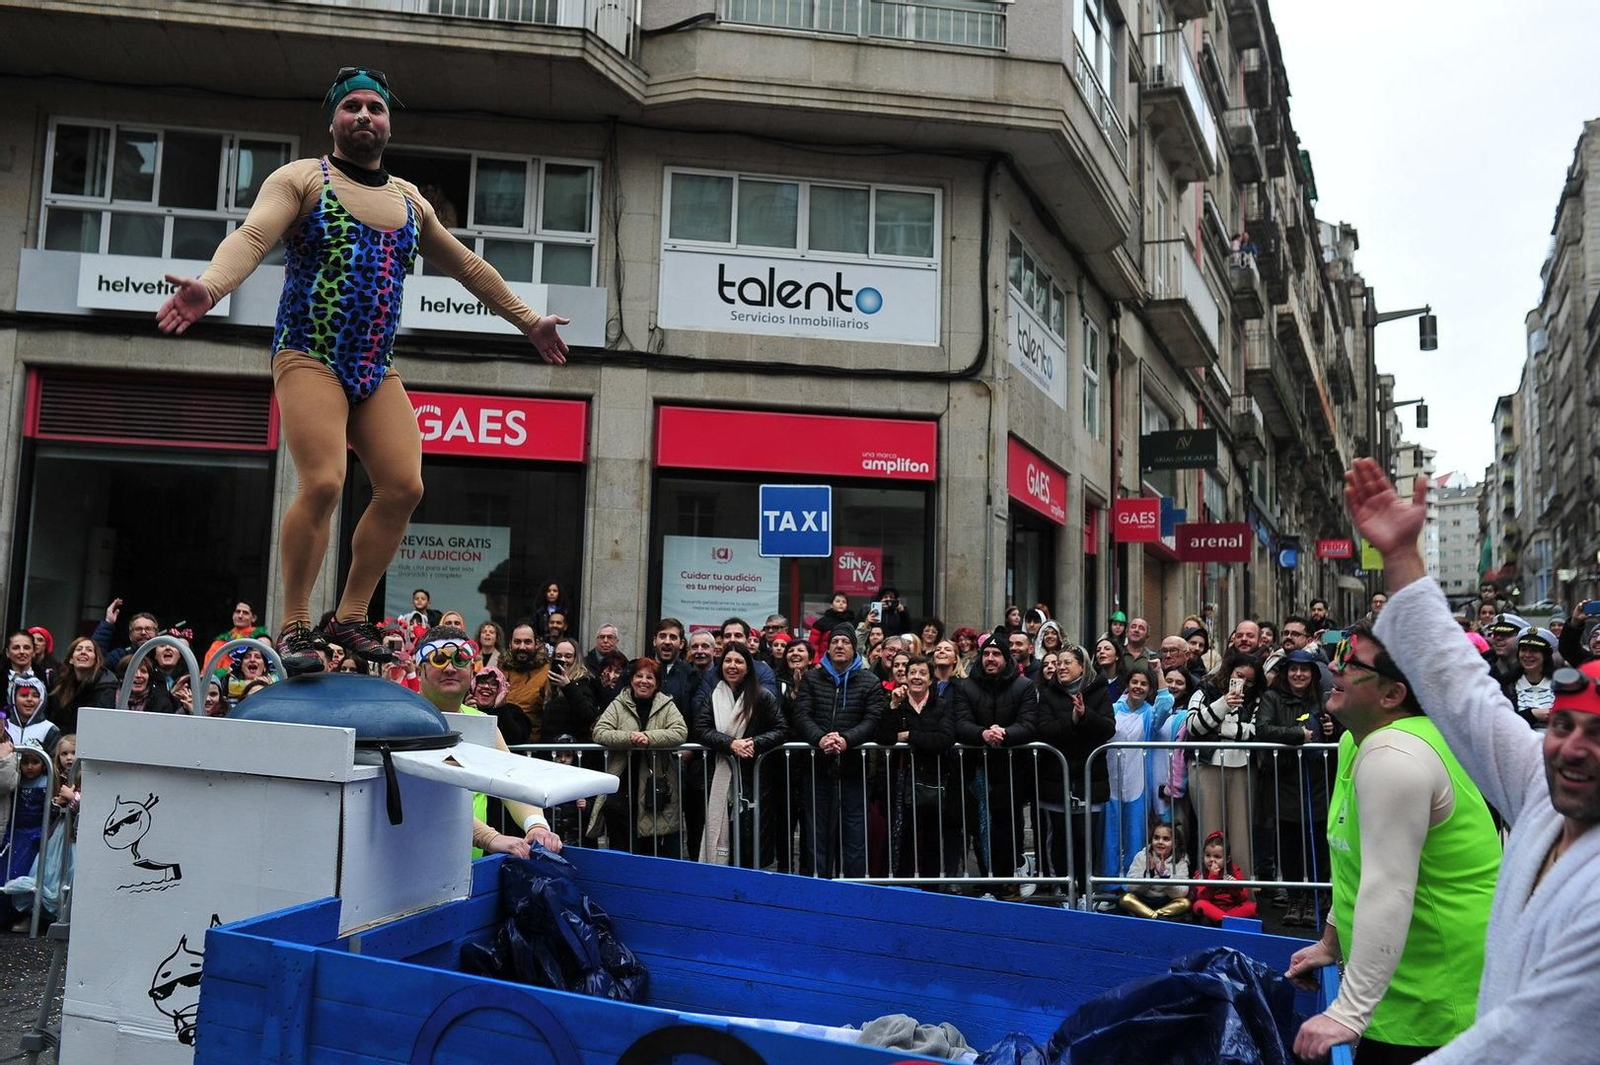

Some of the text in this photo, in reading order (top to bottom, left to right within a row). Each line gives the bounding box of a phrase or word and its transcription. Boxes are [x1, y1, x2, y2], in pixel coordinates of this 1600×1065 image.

[718, 263, 883, 315] talento
[730, 310, 869, 330] Servicios Inmobiliarios
[1017, 312, 1053, 380] talento
[413, 404, 527, 446] GAES
[862, 457, 929, 474] amplifon
[1026, 462, 1050, 505] GAES
[763, 511, 828, 532] TAXI
[1118, 511, 1156, 524] GAES
[448, 537, 491, 549] GRATIS
[1190, 534, 1243, 548] arenal
[400, 548, 482, 561] TU AUDICIÓN
[680, 571, 762, 583] Cuidar tu audición
[708, 584, 734, 593] mejor
[736, 585, 757, 593] plan
